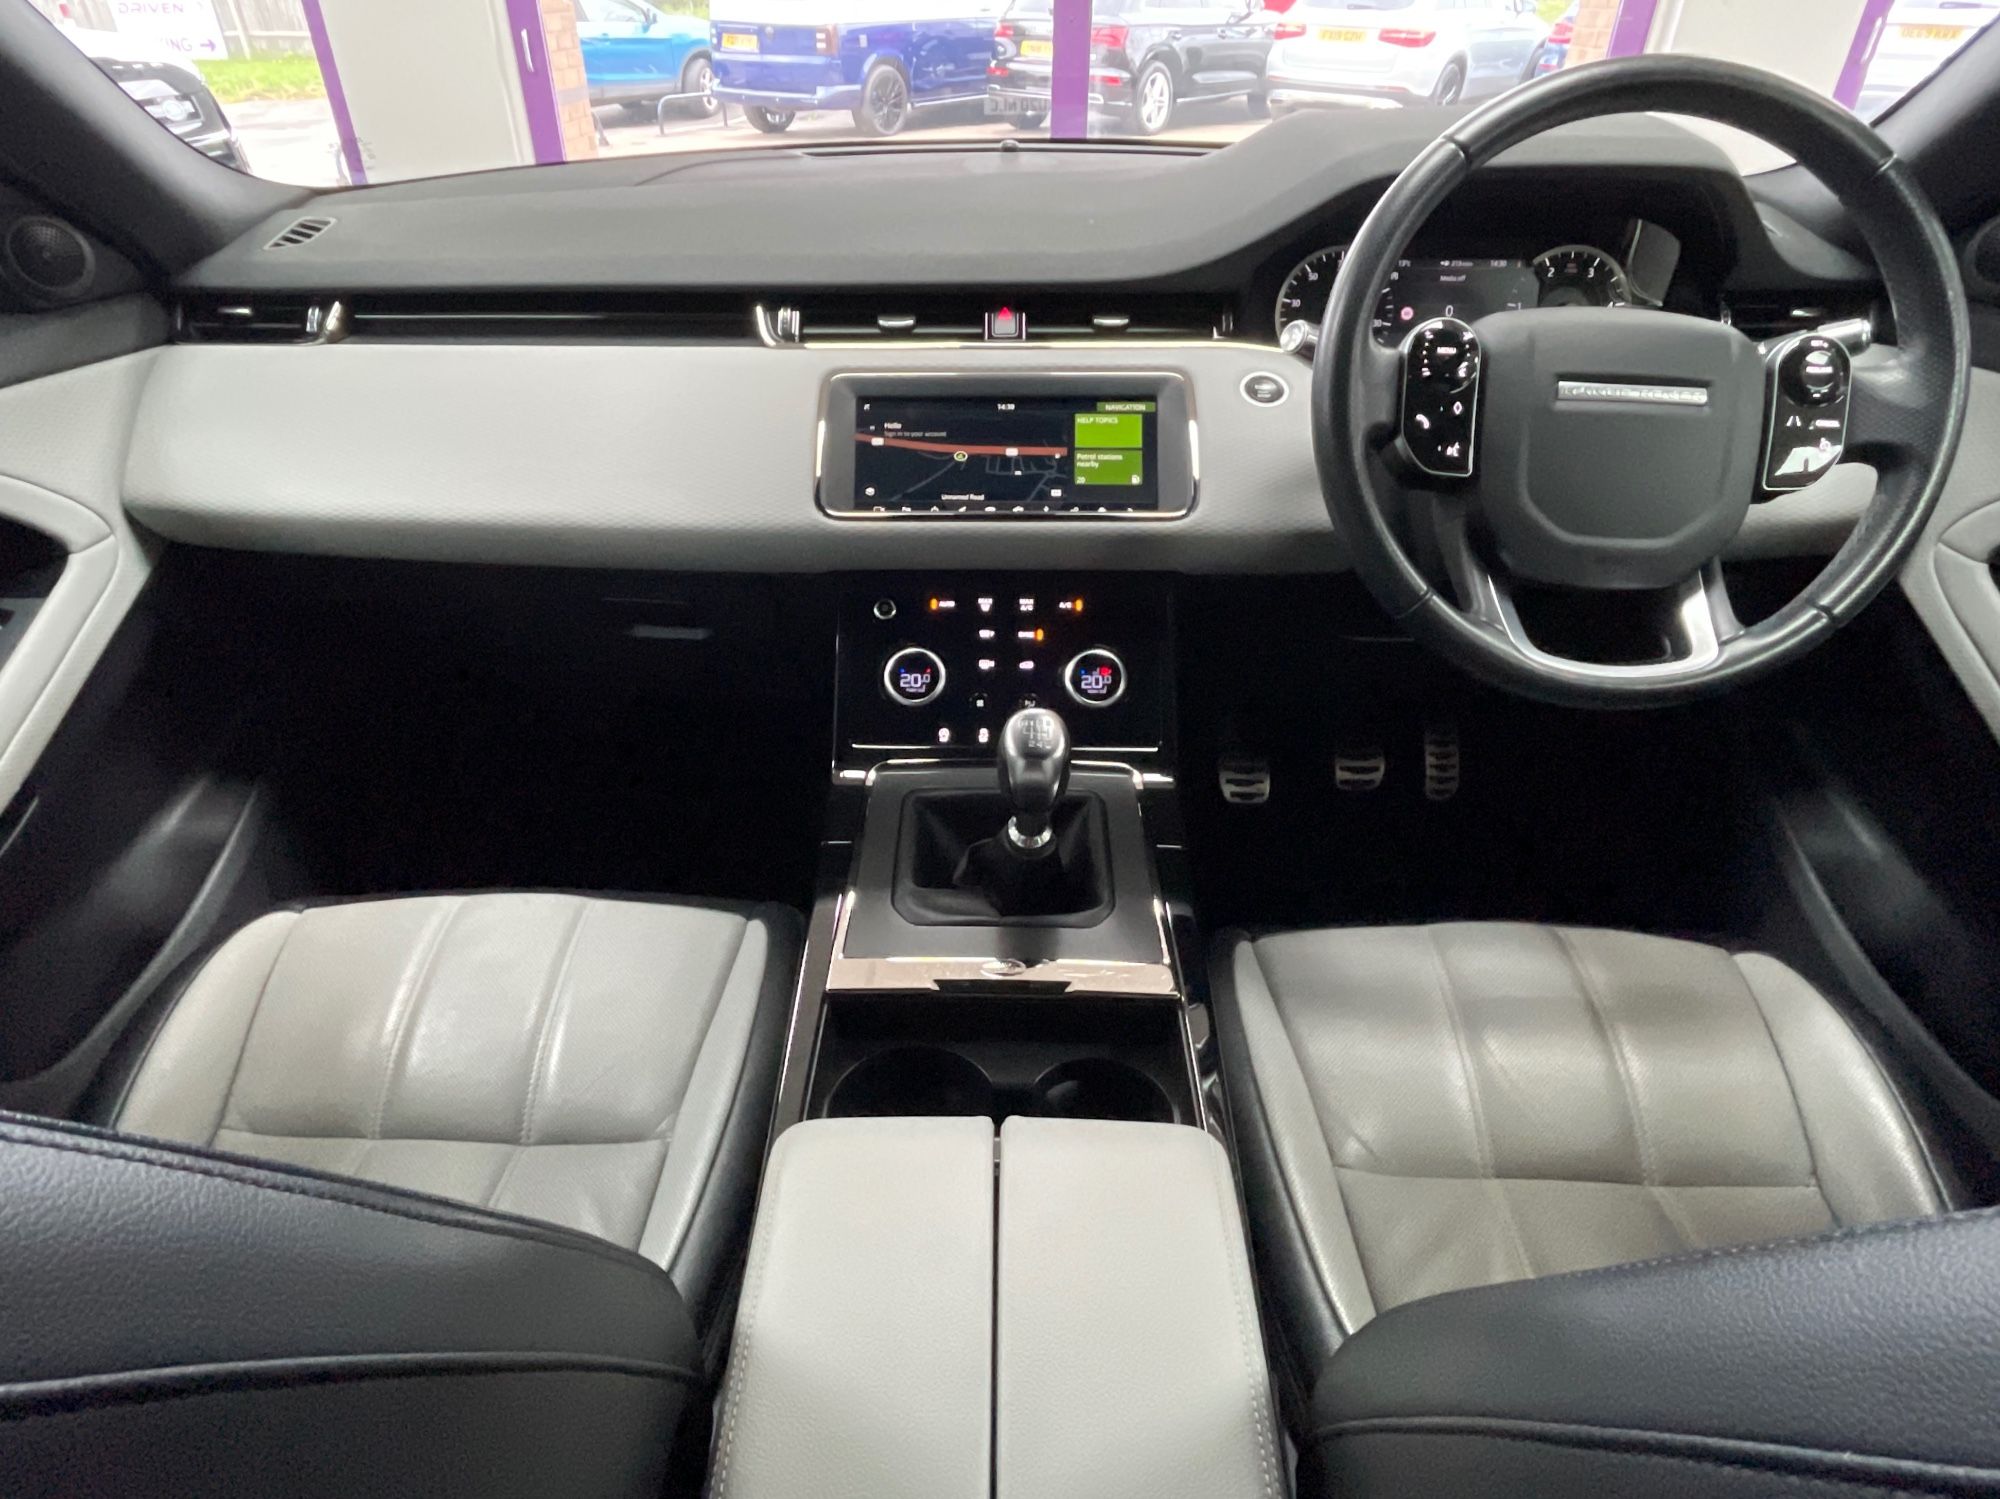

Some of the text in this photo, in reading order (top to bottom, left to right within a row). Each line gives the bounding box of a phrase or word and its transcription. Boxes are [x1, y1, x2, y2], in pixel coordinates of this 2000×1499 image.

[118, 2, 184, 14] DRIVEN
[1308, 272, 1319, 281] 50
[1547, 267, 1555, 278] 2
[1587, 267, 1595, 278] 3
[1445, 304, 1454, 318] 0
[1105, 403, 1146, 411] NAVIGATION
[884, 422, 902, 430] Hello
[1077, 453, 1097, 461] Petrol
[1076, 461, 1099, 469] nearby
[1059, 601, 1072, 609] A/C
